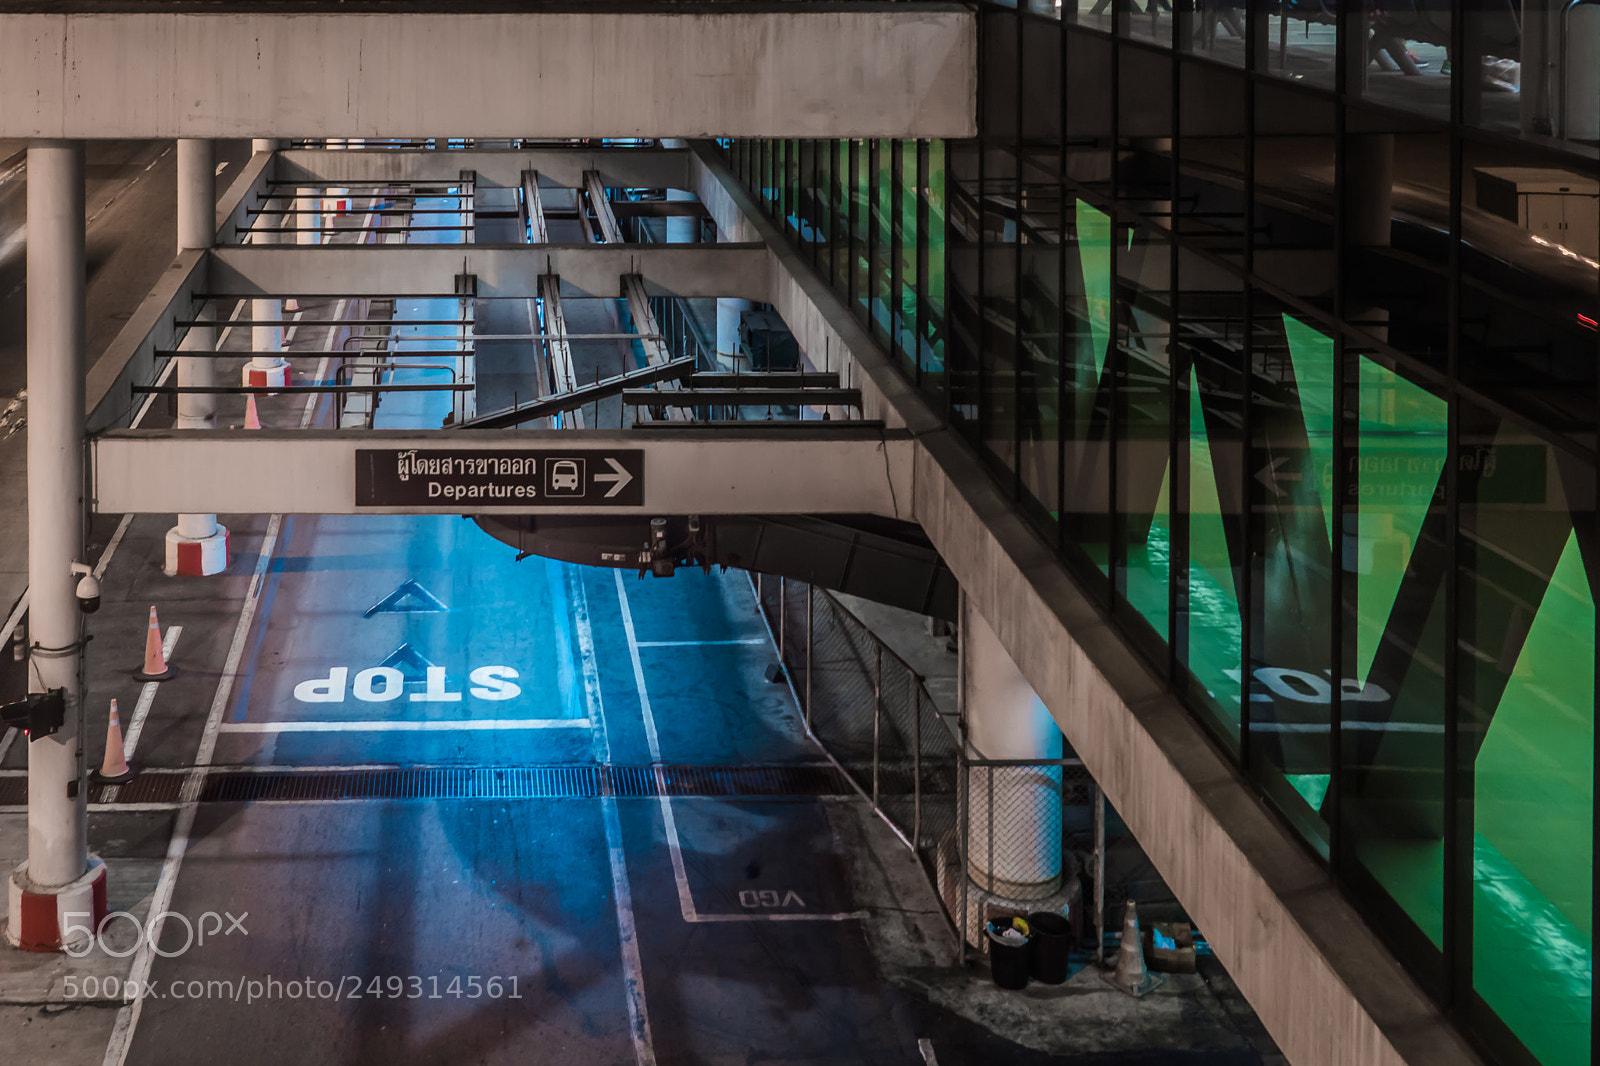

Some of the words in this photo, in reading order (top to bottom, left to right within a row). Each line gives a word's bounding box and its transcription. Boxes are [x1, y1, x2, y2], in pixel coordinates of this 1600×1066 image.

[397, 450, 536, 481] ผู้โดยสารขาออก
[428, 482, 536, 500] Departures
[293, 665, 522, 702] STOP
